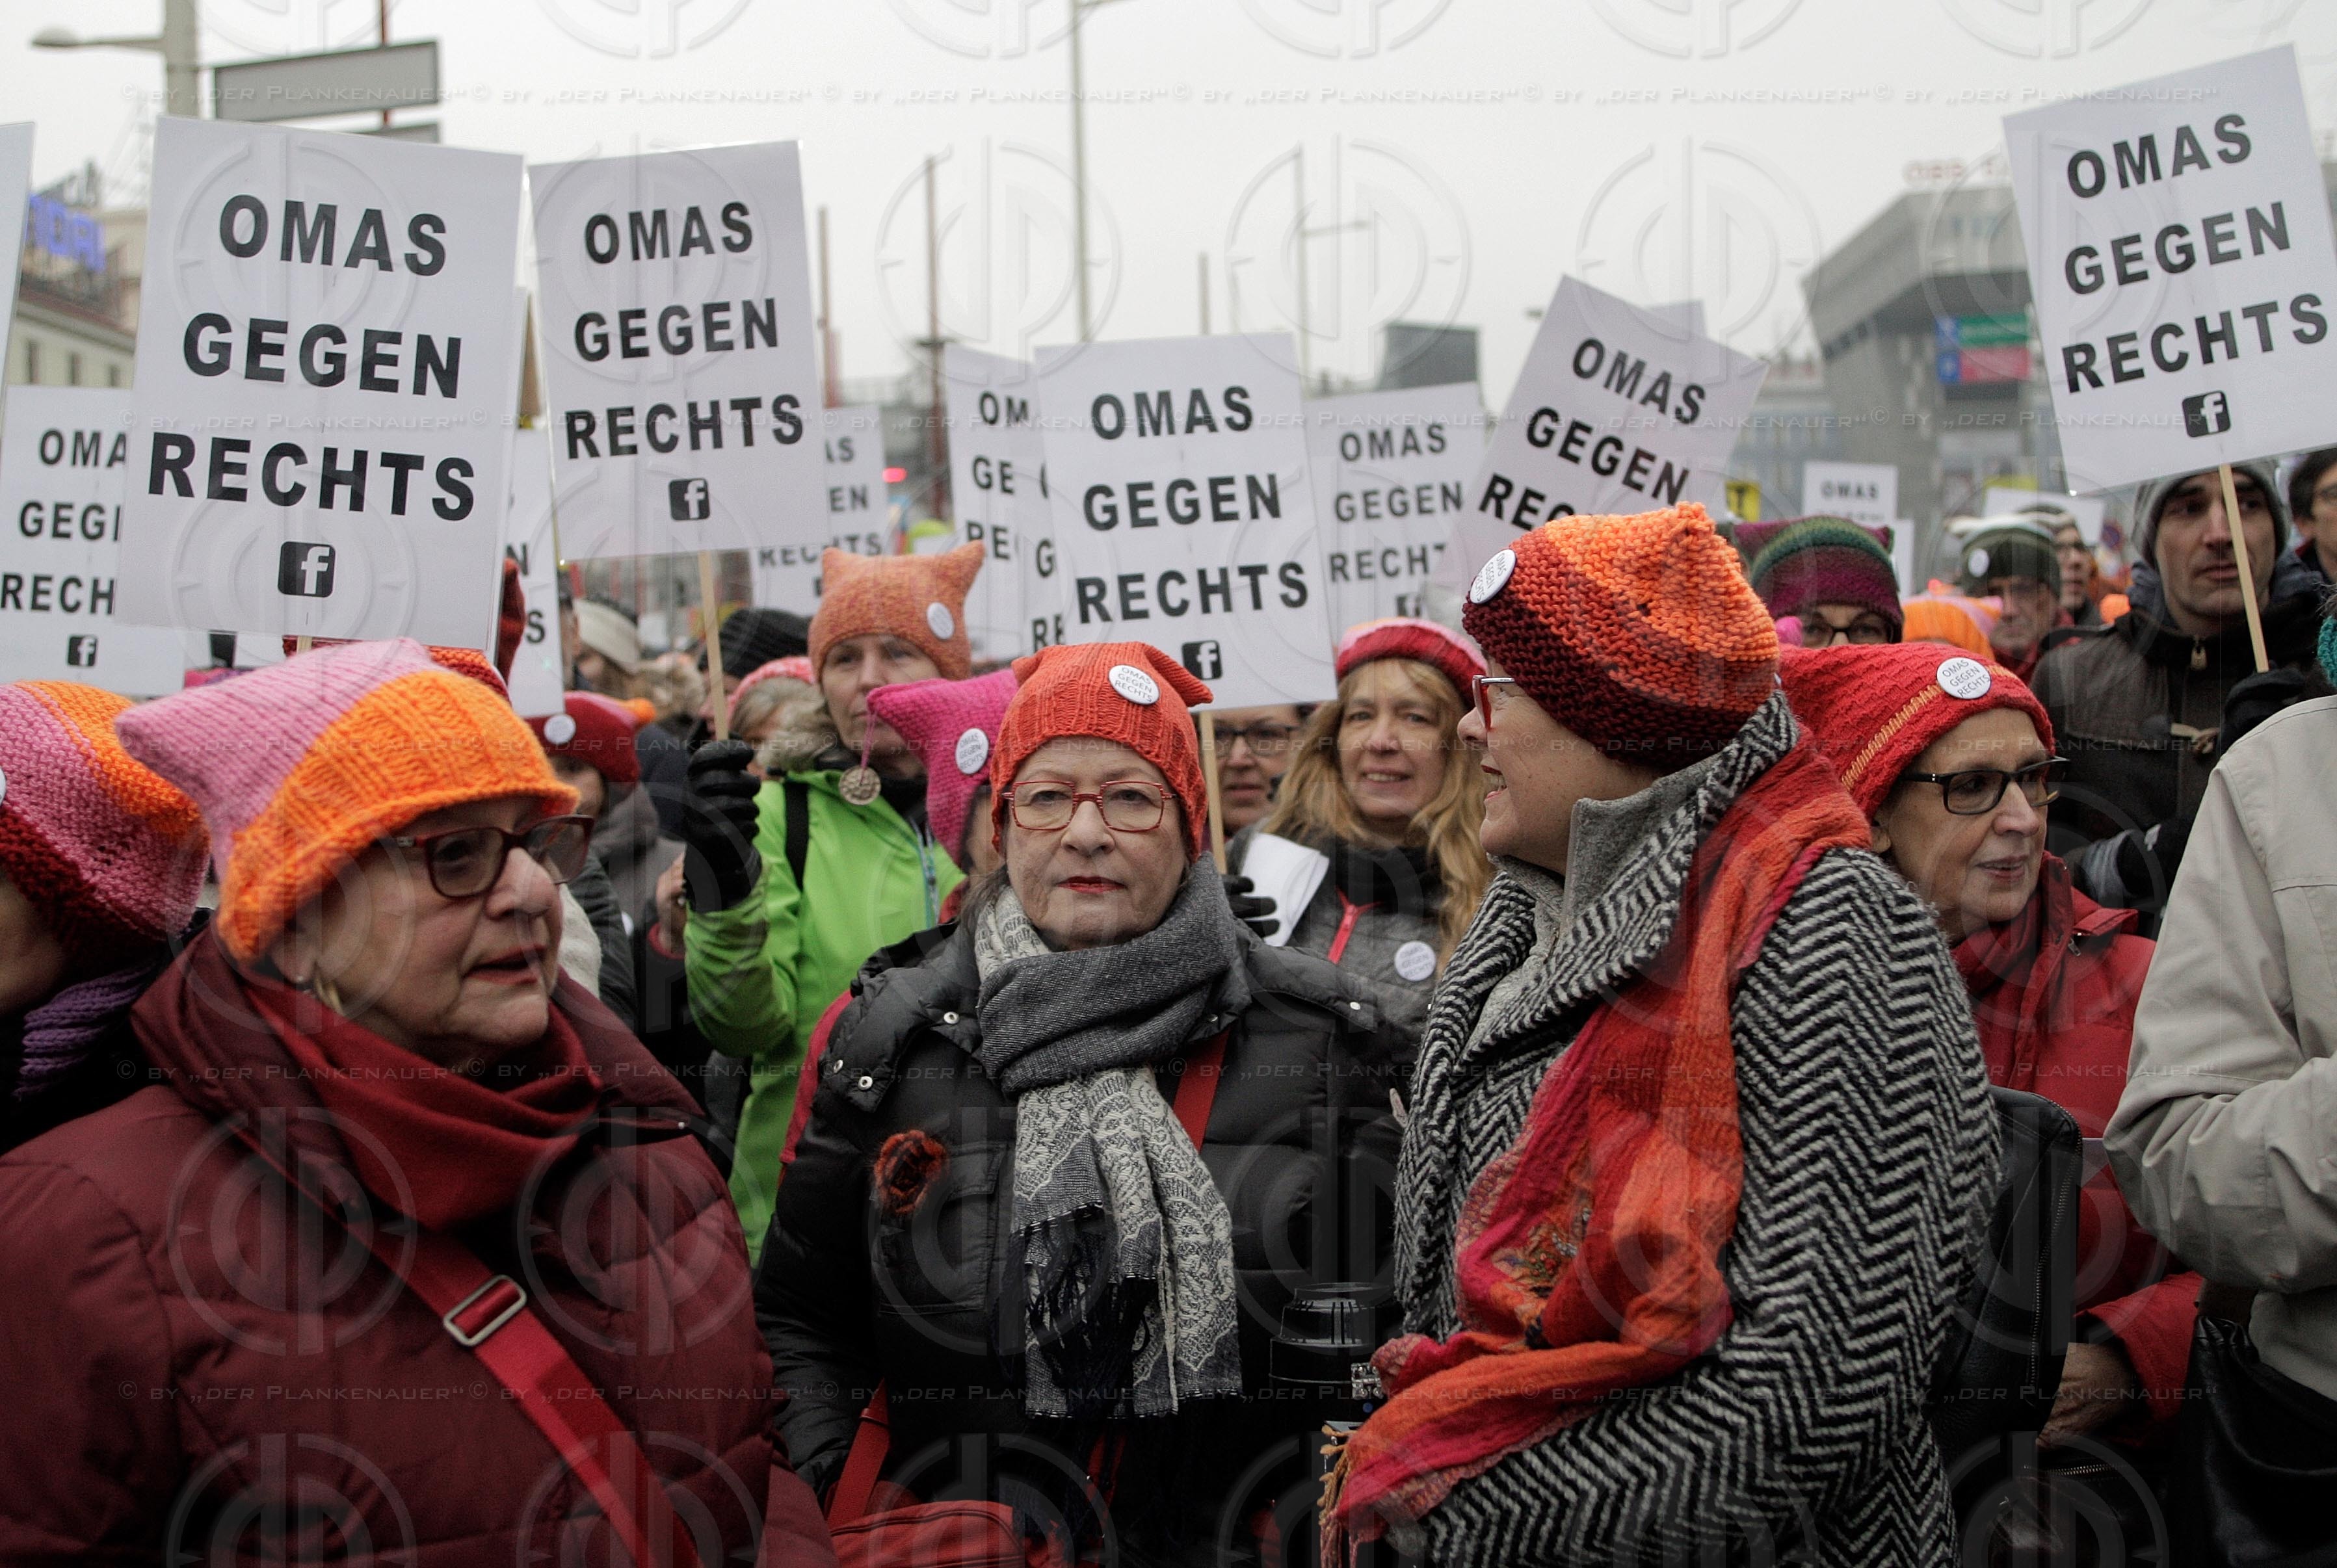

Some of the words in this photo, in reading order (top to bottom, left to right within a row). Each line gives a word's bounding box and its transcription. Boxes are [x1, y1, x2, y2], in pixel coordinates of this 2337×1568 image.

[2068, 115, 2251, 198] OMAS
[220, 195, 445, 276] OMAS
[585, 202, 752, 264] OMAS
[2065, 202, 2290, 294] GEGEN
[575, 298, 777, 361] GEGEN
[2063, 294, 2327, 393] RECHTS
[184, 313, 460, 398] GEGEN
[1573, 341, 1705, 425] OMAS
[566, 395, 802, 459] RECHTS
[979, 392, 1027, 425] OM
[1092, 387, 1252, 439] OMAS
[40, 430, 126, 467] OMA
[1341, 424, 1446, 461] OMAS
[1527, 408, 1689, 506] GEGEN
[149, 432, 473, 521] RECHTS
[20, 502, 120, 541] GEG
[1084, 475, 1280, 530] GEGEN
[1335, 483, 1462, 522] GEGEN
[1330, 544, 1445, 582] RECHT
[1485, 562, 1496, 589] GEGEN
[1496, 553, 1507, 577] OMAS
[1, 574, 114, 614] RECH
[1076, 562, 1308, 623] RECHTS
[1118, 673, 1152, 693] GEGEN
[1122, 667, 1151, 685] OMAS
[1942, 659, 1969, 677] OMAS
[1949, 666, 1980, 686] GEGEN
[1957, 674, 1990, 698] RECHTS
[1115, 679, 1153, 702] RECHTS
